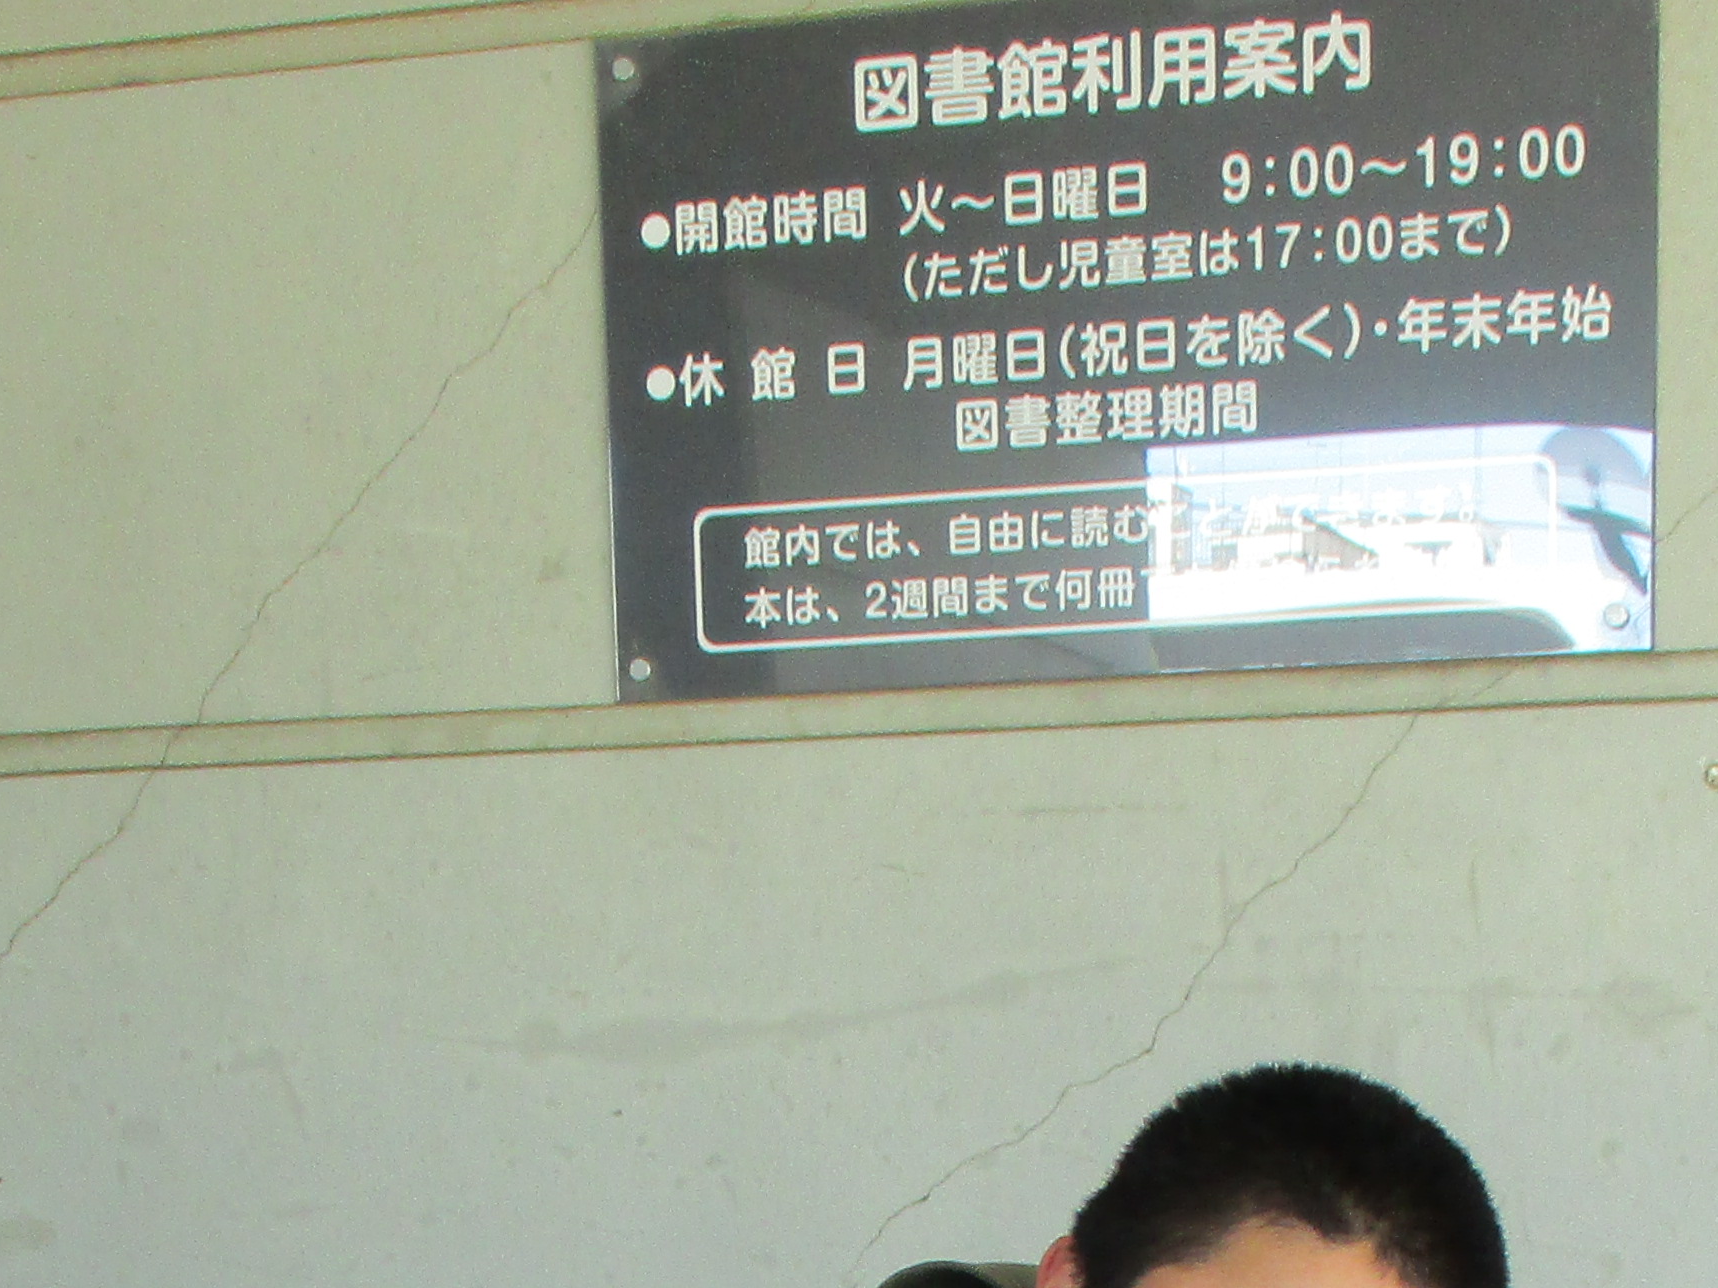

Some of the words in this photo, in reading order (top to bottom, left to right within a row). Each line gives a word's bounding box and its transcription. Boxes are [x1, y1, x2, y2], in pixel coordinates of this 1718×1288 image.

[854, 12, 1372, 132] 図書館利用案内
[674, 189, 867, 257] 開館時間
[955, 381, 1260, 453] 図書整理期間
